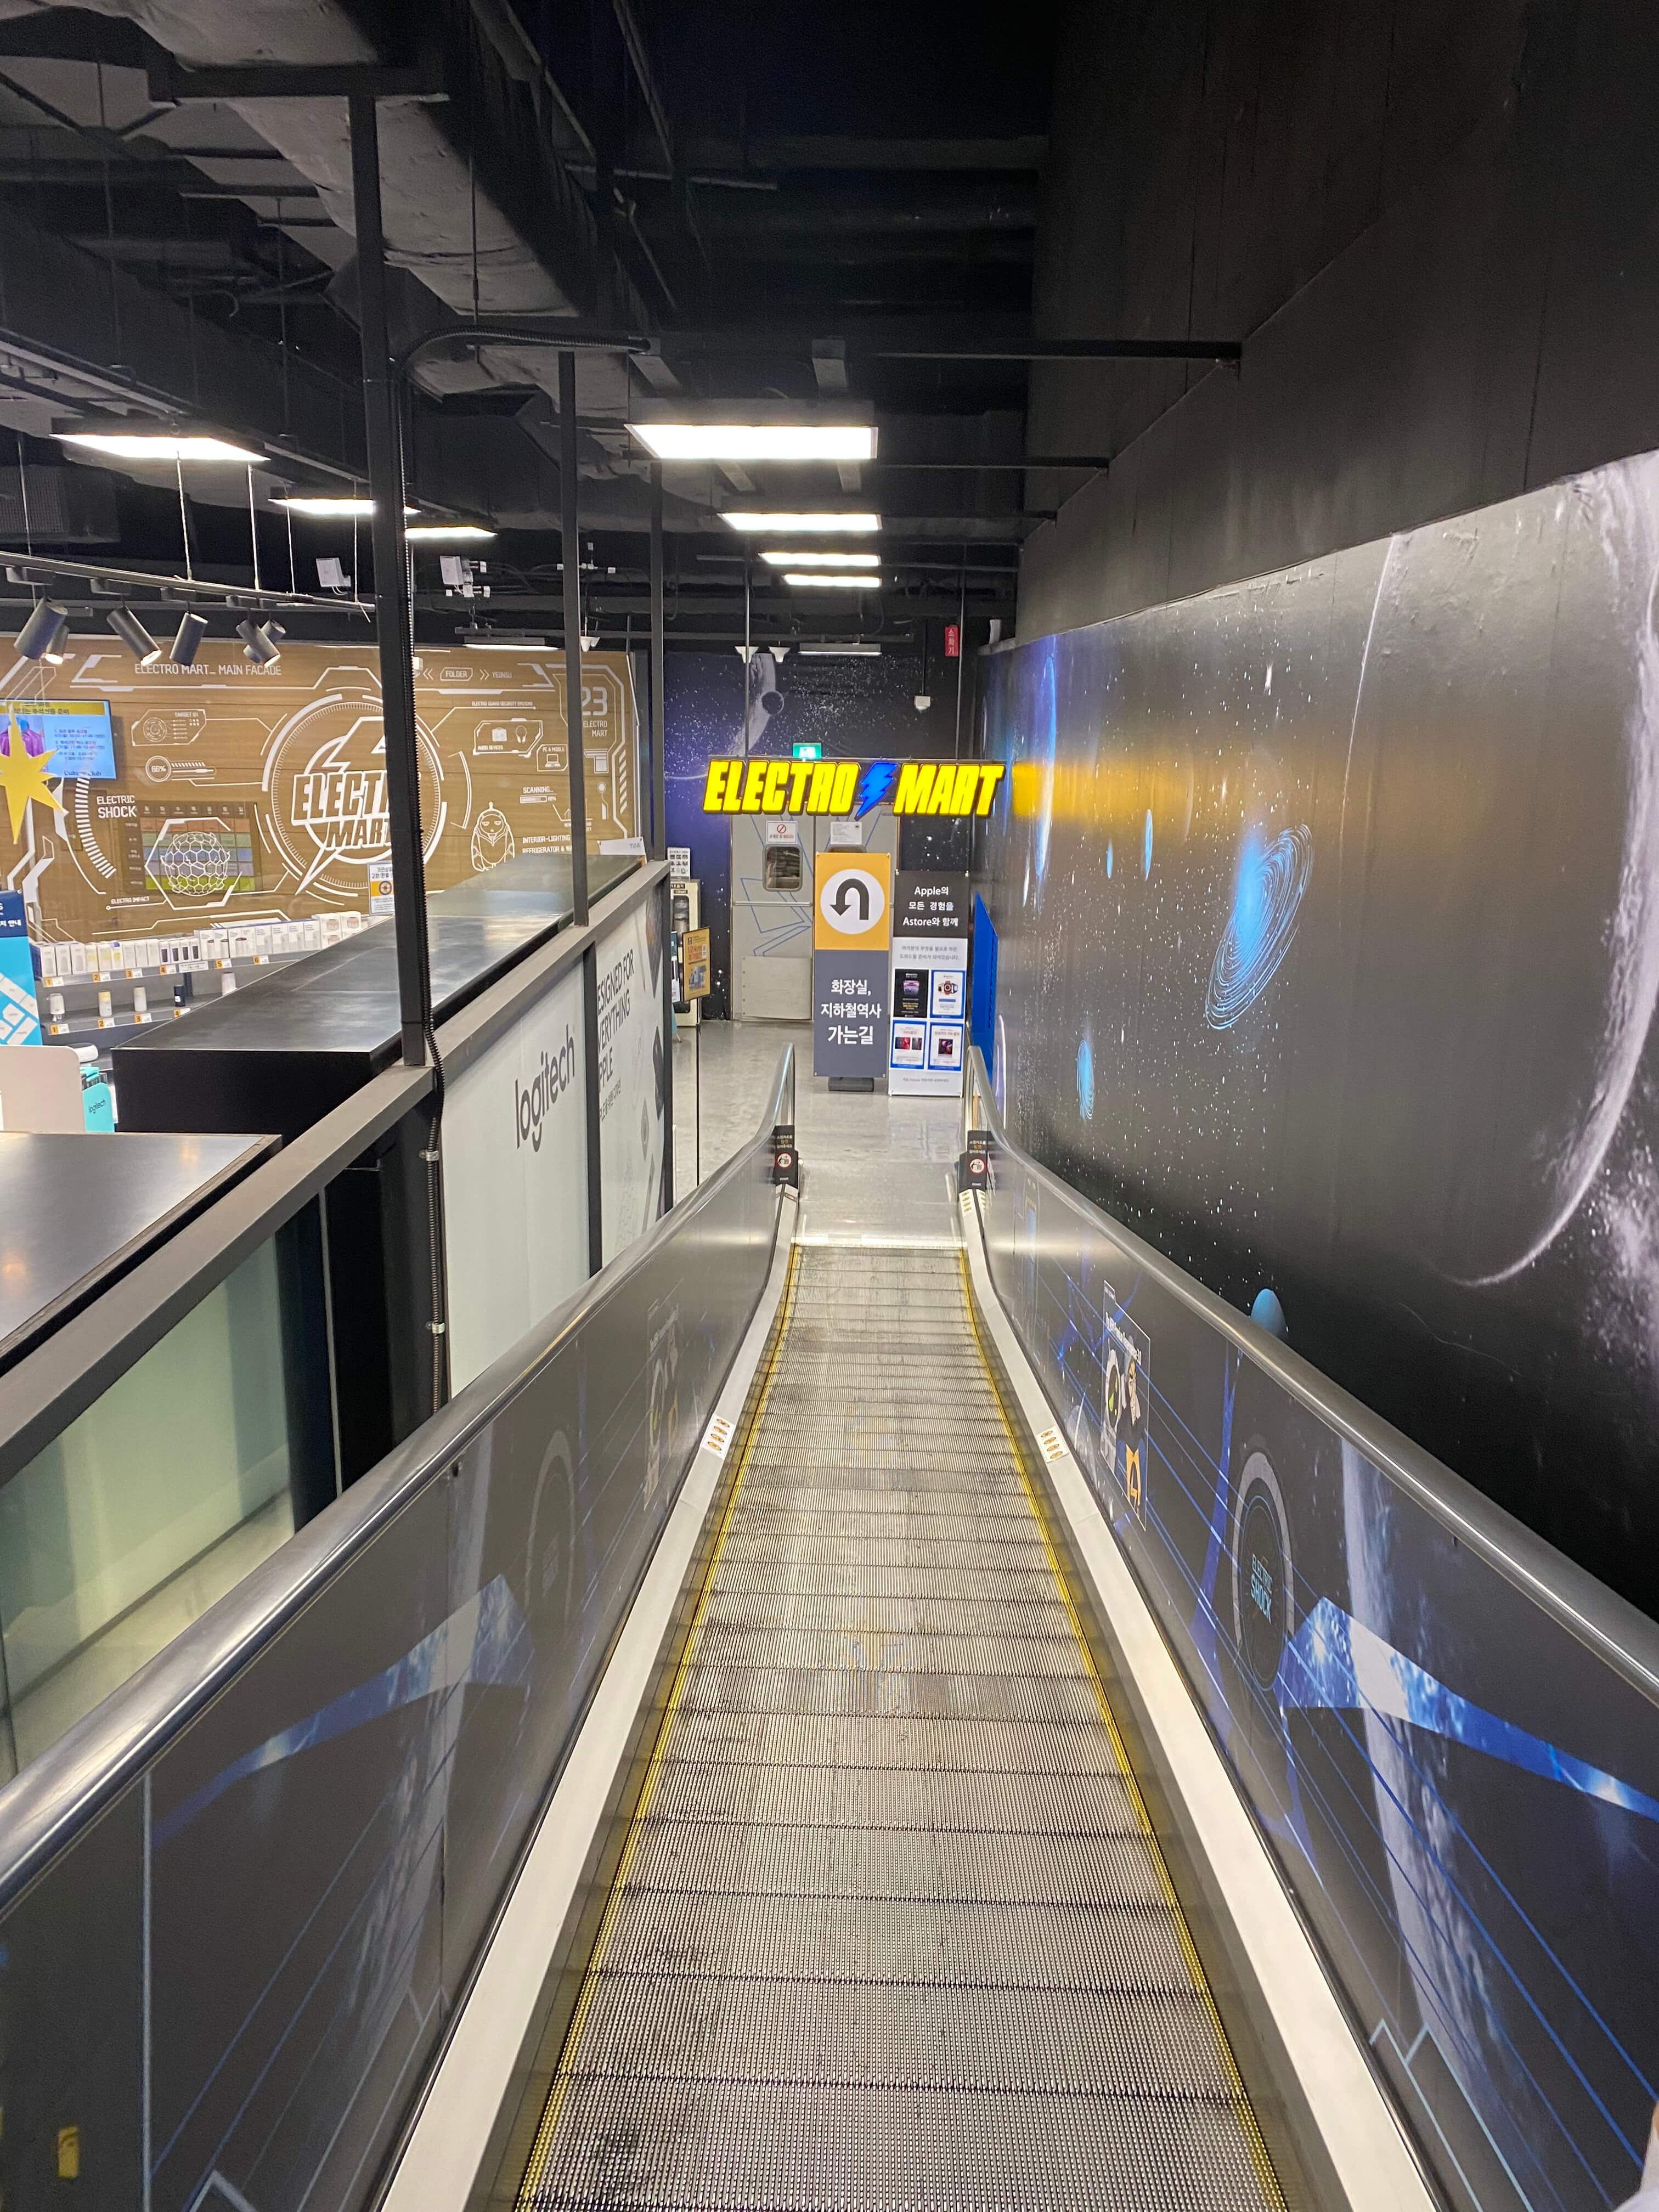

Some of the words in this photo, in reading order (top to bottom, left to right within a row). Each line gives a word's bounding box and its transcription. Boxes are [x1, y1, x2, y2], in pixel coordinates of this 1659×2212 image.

[135, 664, 178, 674] ELECTRO
[218, 665, 243, 675] MAIN
[246, 665, 281, 675] FACADE
[582, 686, 607, 715] 23
[583, 720, 608, 728] ELECTRO
[703, 759, 861, 815] ELECTRO
[893, 763, 1006, 817] MART
[97, 795, 136, 805] ELECTRIC
[98, 805, 137, 819] SHOCK
[914, 886, 949, 897] Apple의
[909, 901, 925, 911] 모든
[930, 901, 954, 911] 경험을
[902, 917, 940, 926] Astore와
[943, 917, 958, 927] 함께
[597, 961, 623, 1015] ESIGNED
[623, 949, 634, 985] FOR
[831, 979, 871, 996] 화장실,
[821, 1002, 882, 1019] 지하철역사
[599, 988, 630, 1053] VERYTHING
[827, 1025, 873, 1045] 가는길
[599, 1046, 613, 1093] PPLE
[515, 1024, 575, 1153] logitech
[1251, 1573, 1272, 1624] SHOCK
